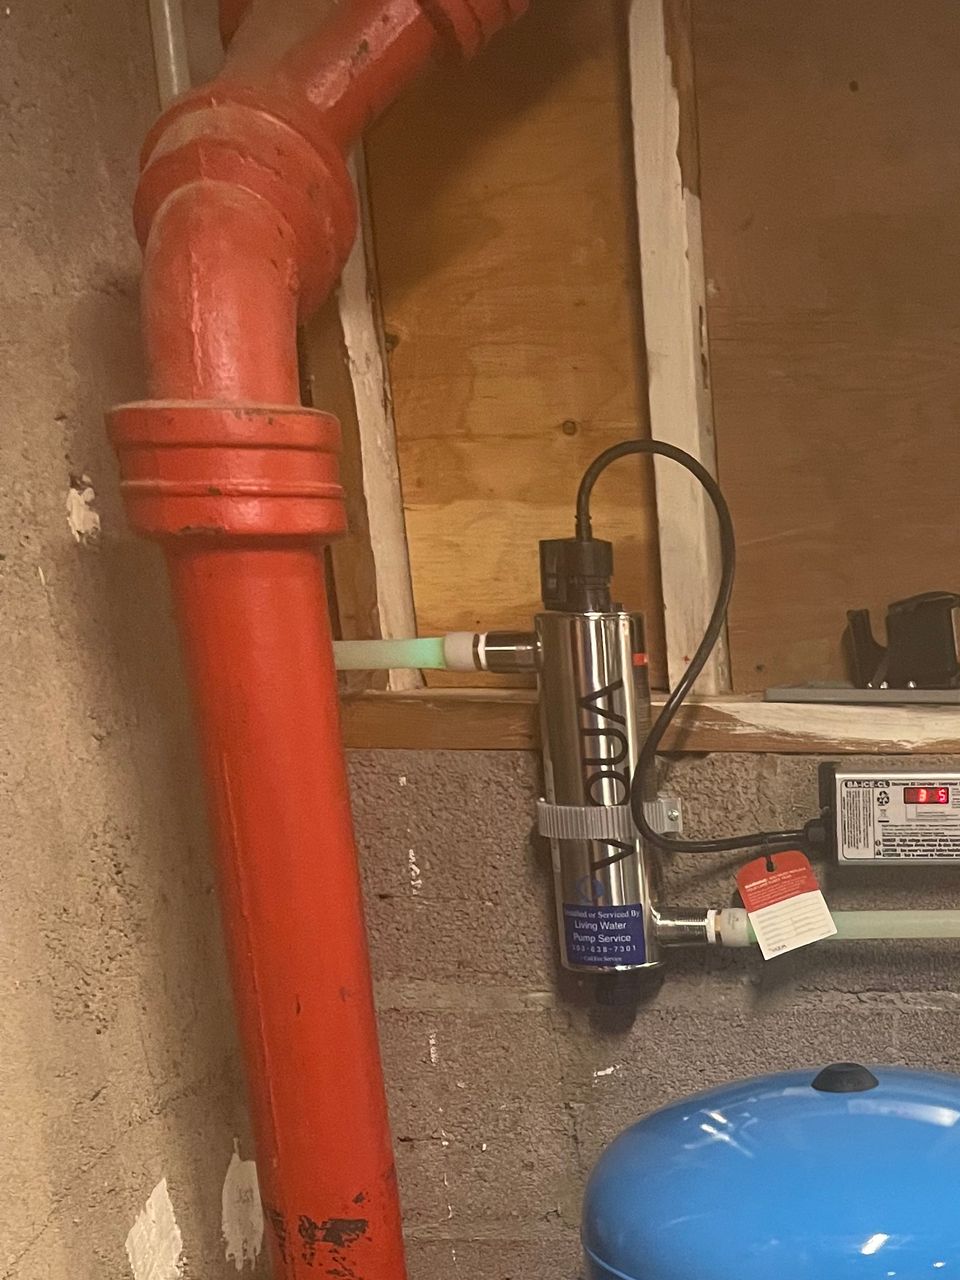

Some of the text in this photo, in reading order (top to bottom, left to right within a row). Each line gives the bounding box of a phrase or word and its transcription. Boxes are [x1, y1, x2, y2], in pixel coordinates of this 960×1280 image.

[579, 679, 637, 873] VQUA
[574, 920, 627, 932] Living Water
[573, 932, 632, 944] Pump Service
